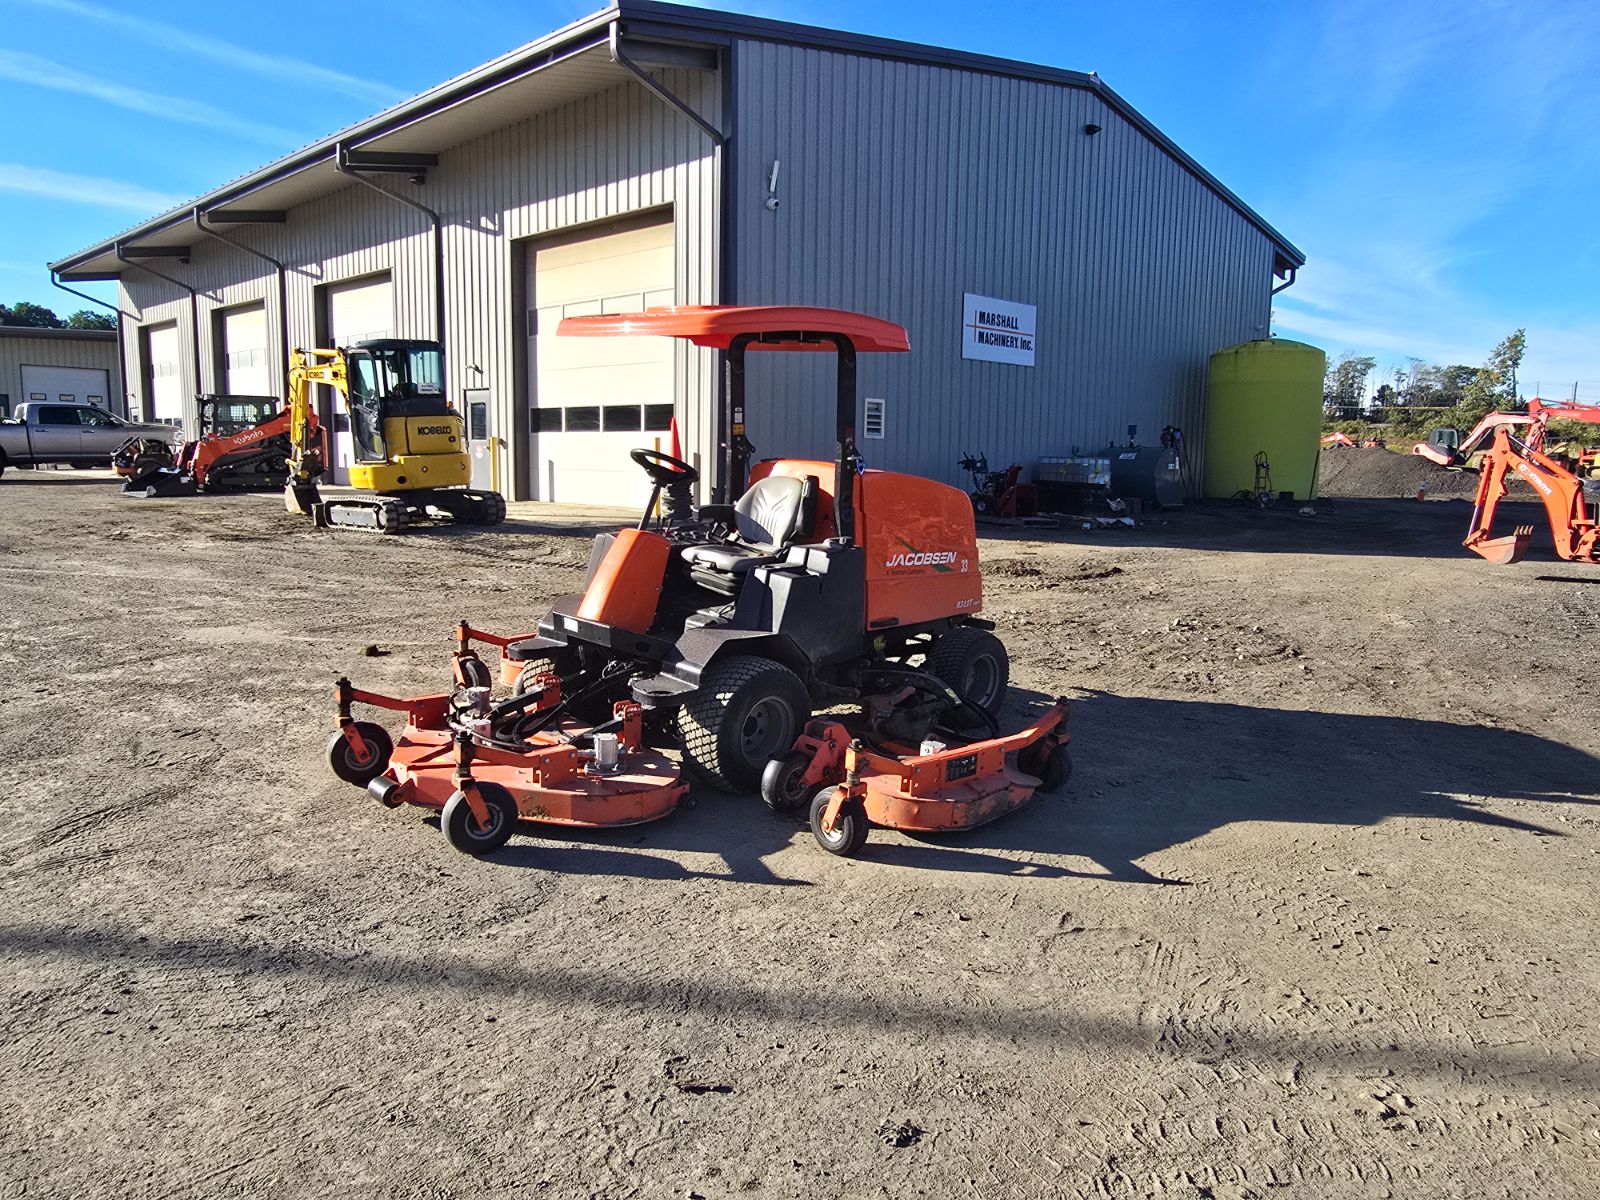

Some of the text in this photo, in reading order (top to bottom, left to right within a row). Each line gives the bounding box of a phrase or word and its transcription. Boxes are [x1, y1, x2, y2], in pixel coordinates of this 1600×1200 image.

[979, 311, 1019, 329] MARSHALL
[233, 430, 263, 444] Kubota
[417, 426, 452, 435] KOBELCO
[886, 552, 957, 567] JACOBSEN
